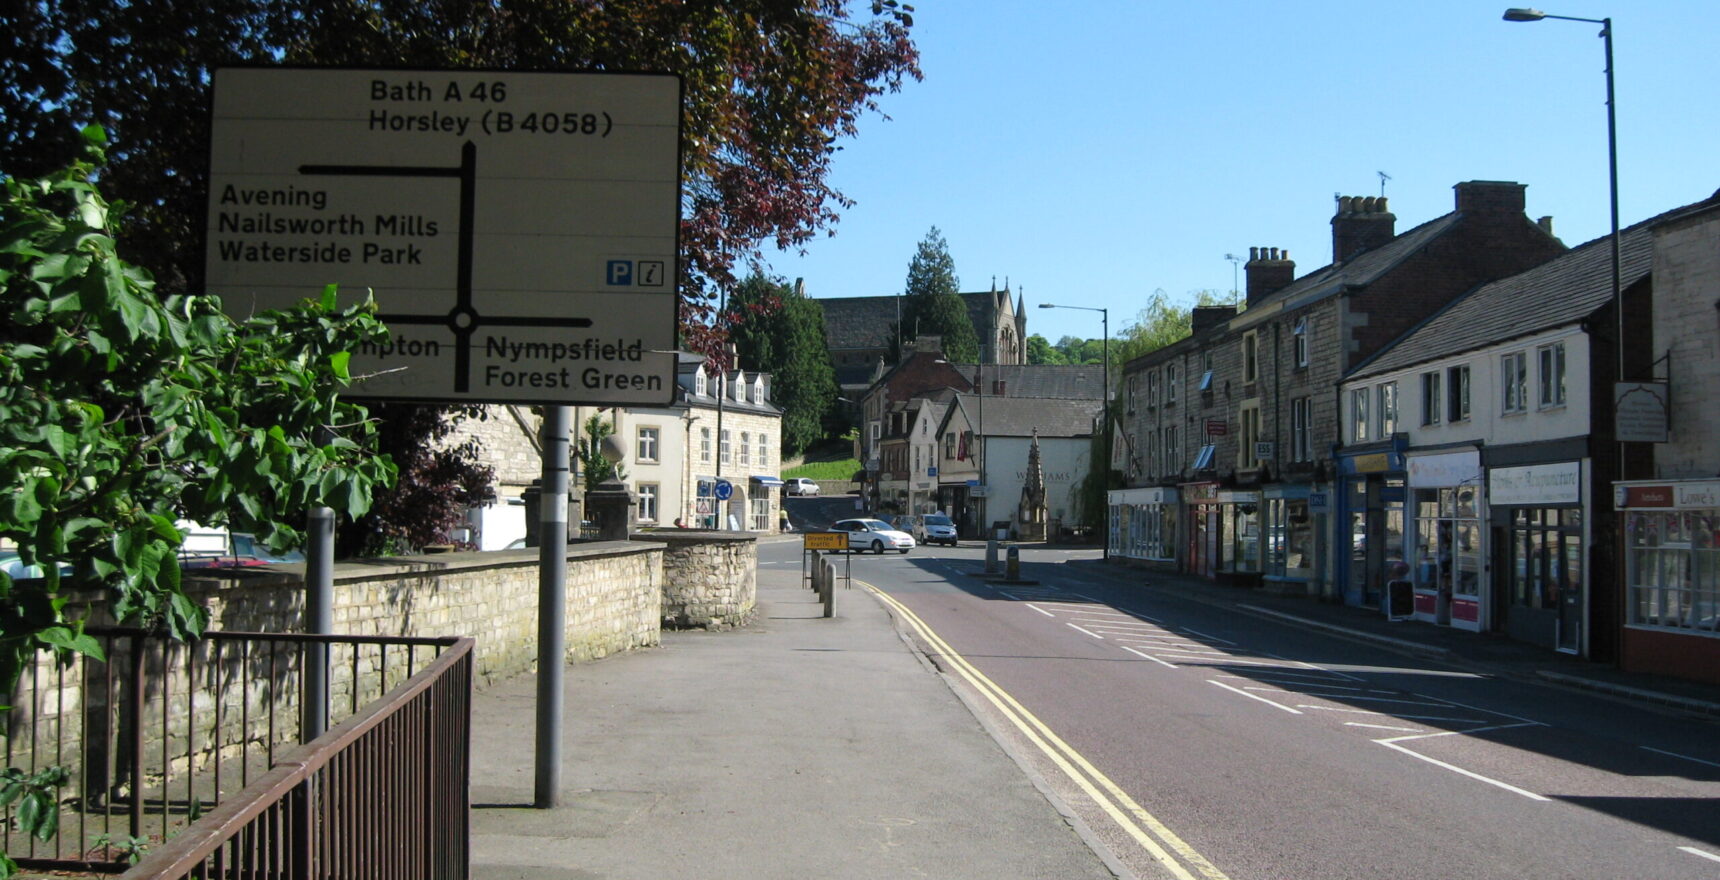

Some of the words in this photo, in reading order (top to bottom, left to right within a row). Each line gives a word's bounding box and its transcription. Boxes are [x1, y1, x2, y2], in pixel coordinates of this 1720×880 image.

[371, 81, 432, 102] Bath
[443, 82, 463, 102] A
[470, 82, 508, 103] 46
[369, 111, 470, 136] Horsley
[220, 184, 327, 209] Avening
[218, 213, 365, 235] Nailsworth
[375, 215, 439, 237] Mills
[219, 240, 352, 264] Waterside
[363, 243, 422, 265] Park
[486, 337, 643, 364] Nympsfield
[485, 366, 569, 389] Forest
[582, 369, 663, 391] Green
